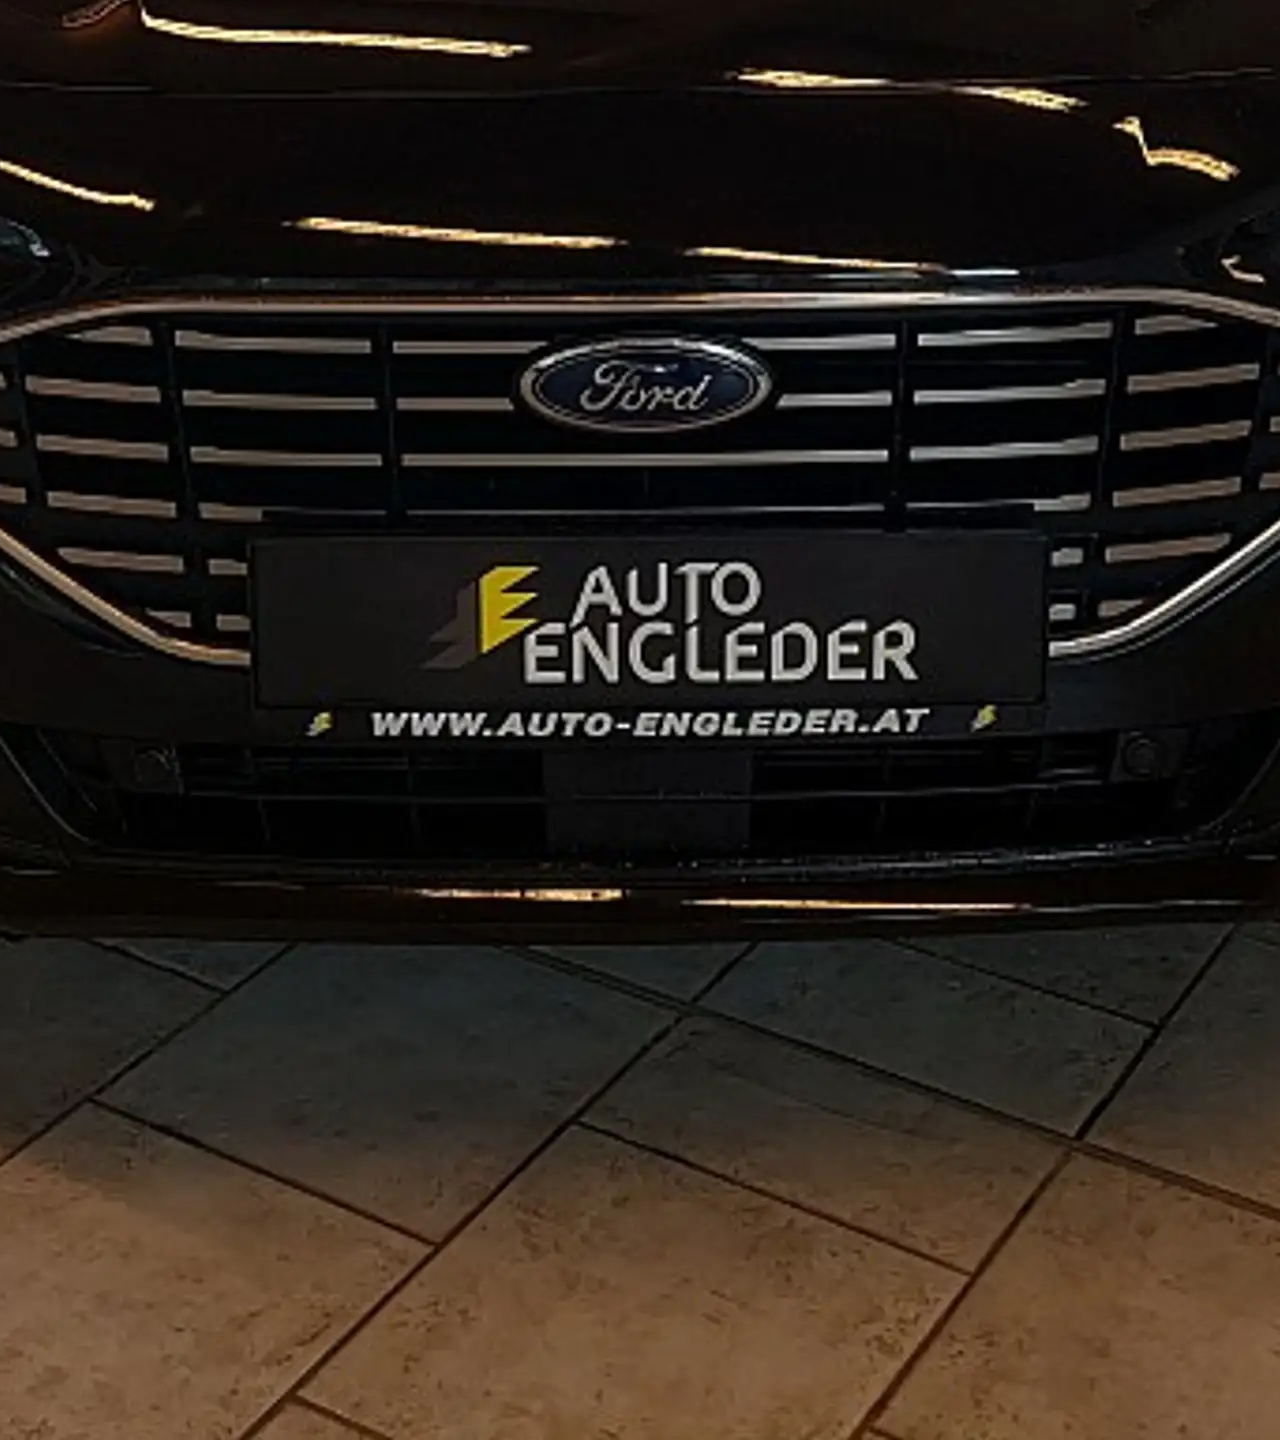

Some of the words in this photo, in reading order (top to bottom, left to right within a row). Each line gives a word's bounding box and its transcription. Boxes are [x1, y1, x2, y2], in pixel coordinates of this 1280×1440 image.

[580, 359, 713, 411] Ford
[570, 561, 763, 627] AUTO
[524, 620, 919, 684] ENGLEDER
[371, 708, 930, 738] WWW.AUTO-ENGLEDER.AT
